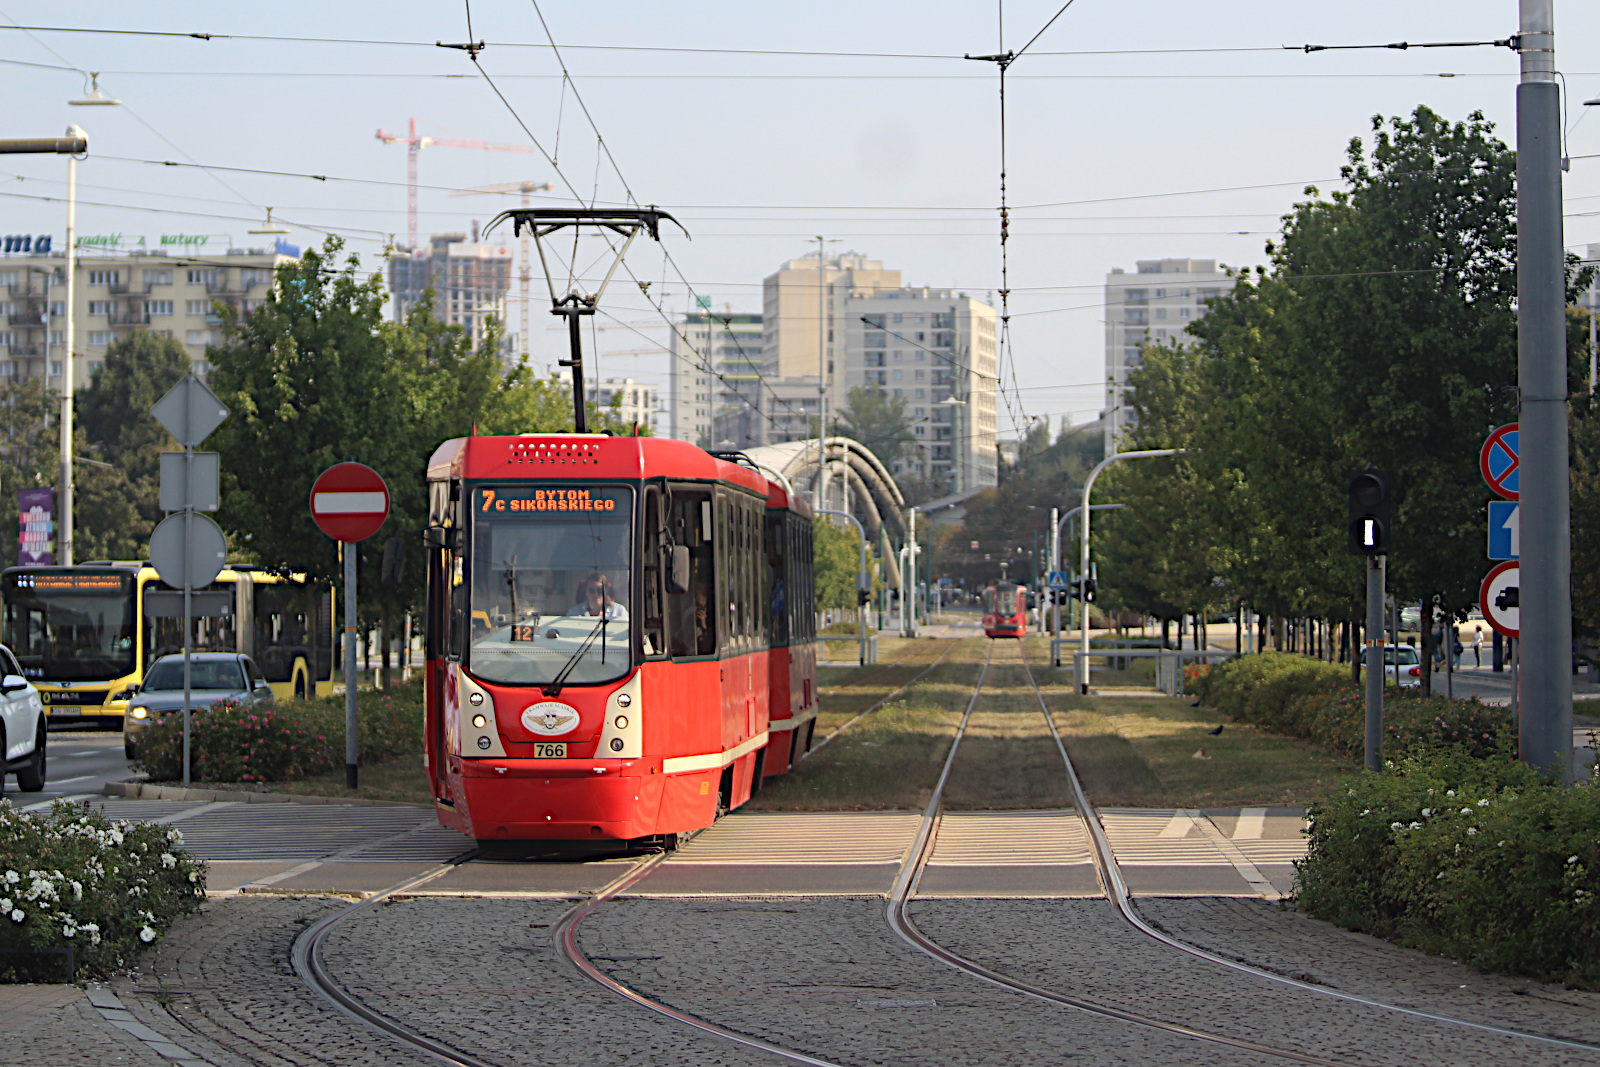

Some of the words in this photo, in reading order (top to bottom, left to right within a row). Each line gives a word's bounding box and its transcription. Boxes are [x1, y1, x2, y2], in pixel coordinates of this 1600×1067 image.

[0, 234, 52, 252] ma
[161, 233, 209, 246] natury
[482, 490, 496, 512] 7
[535, 490, 590, 500] BYTOM
[510, 500, 615, 511] SIKORSKIEGO
[514, 626, 532, 641] 12
[536, 744, 564, 757] 766
